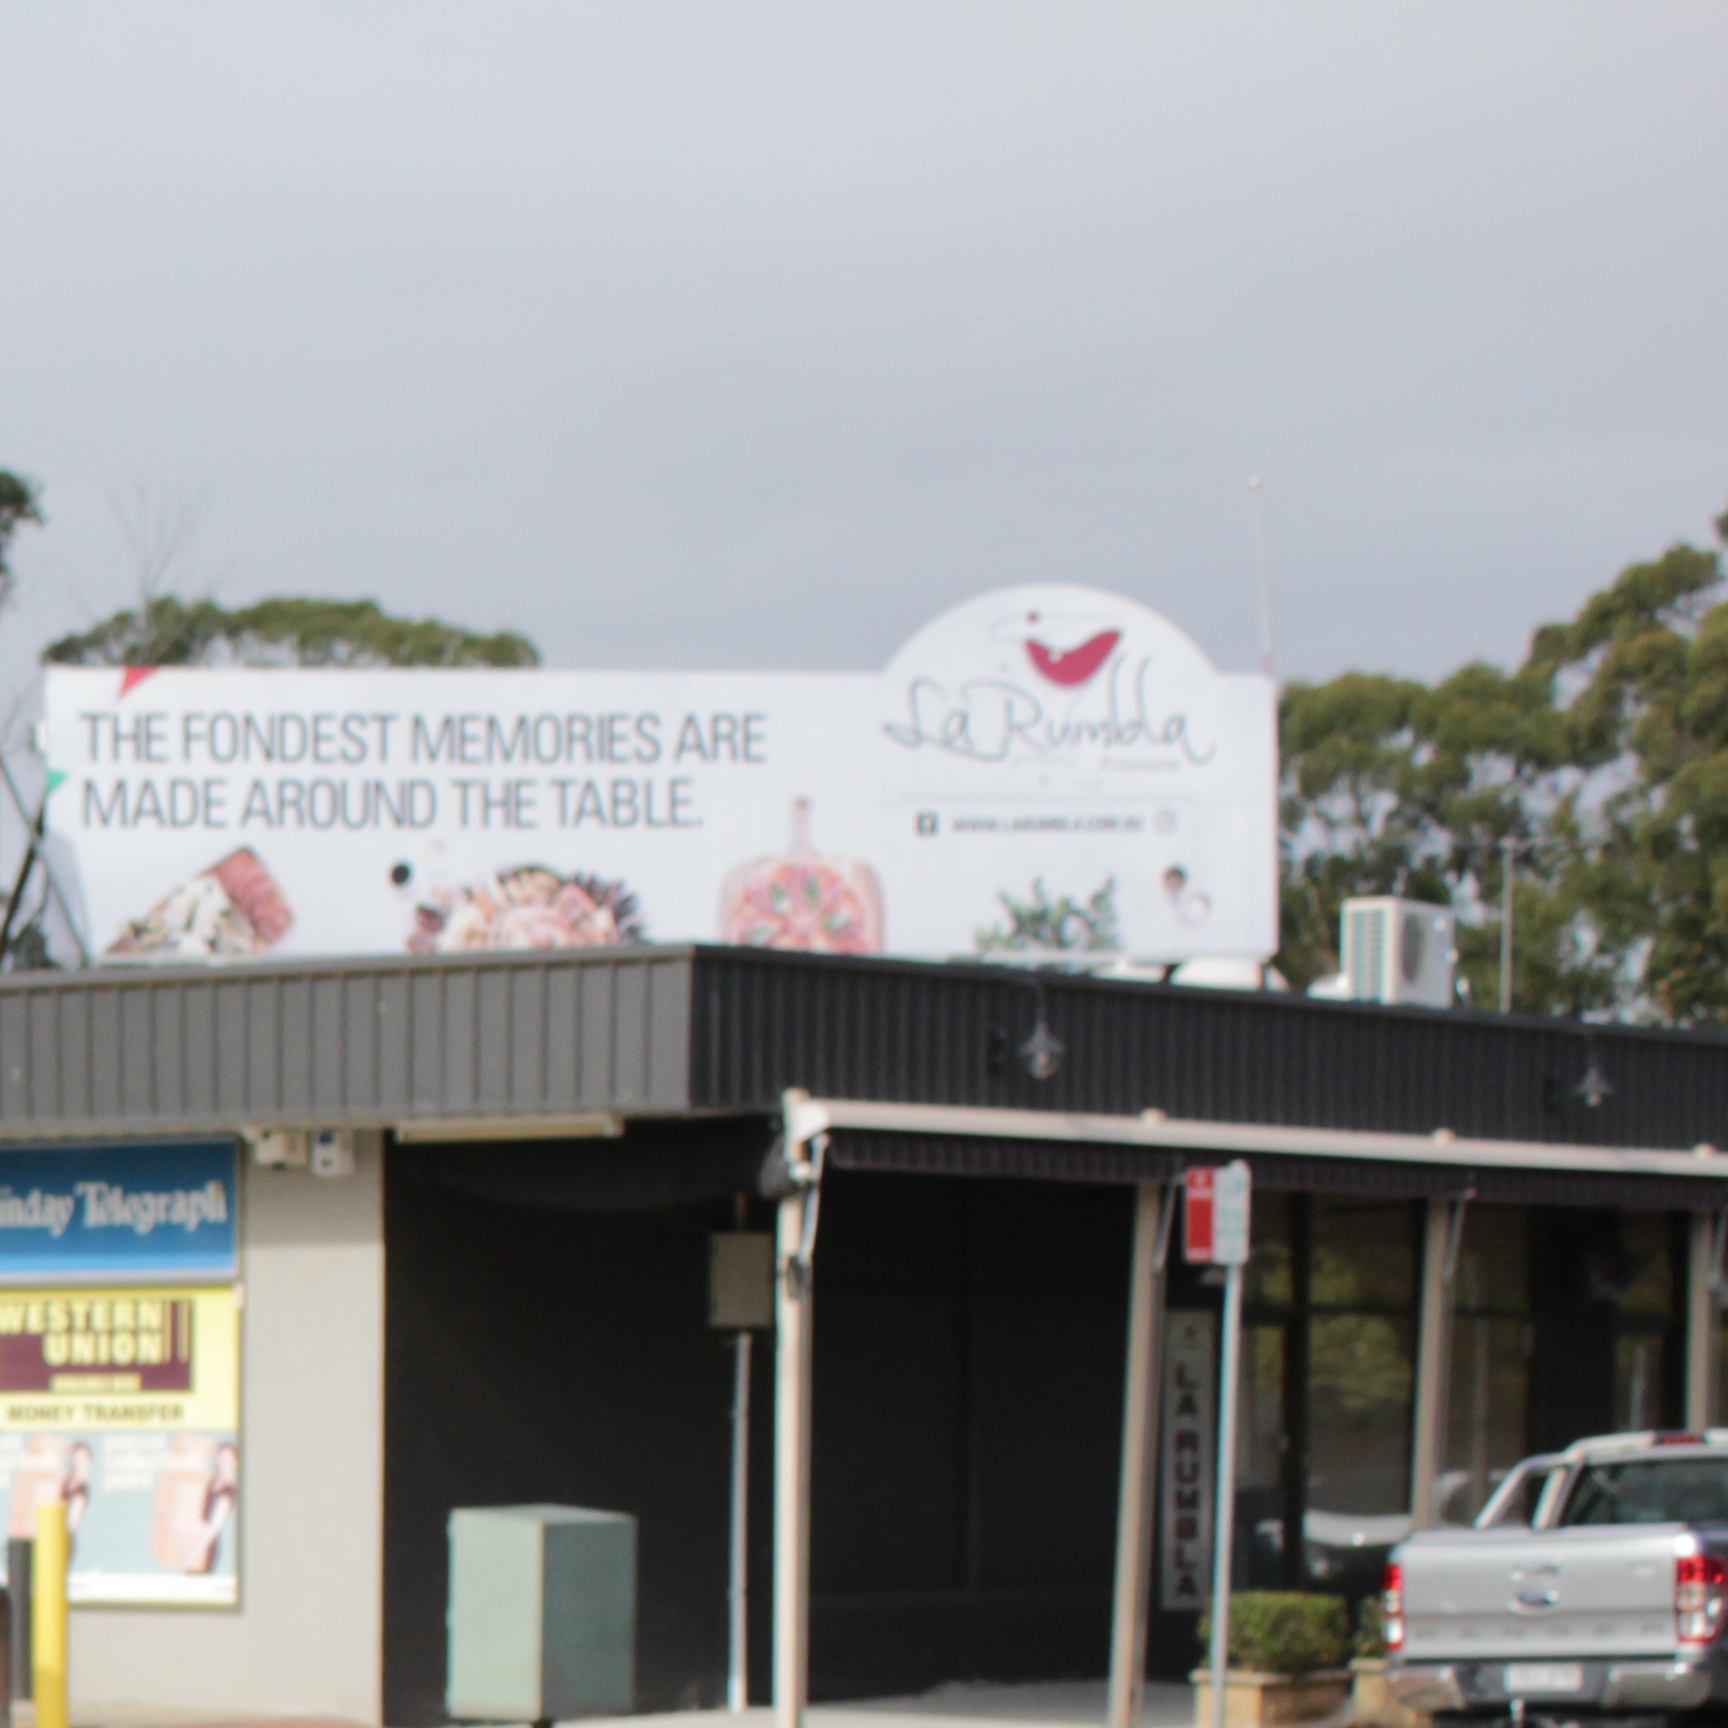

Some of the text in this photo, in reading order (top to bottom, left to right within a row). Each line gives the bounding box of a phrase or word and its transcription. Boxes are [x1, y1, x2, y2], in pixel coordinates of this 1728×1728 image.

[81, 711, 768, 764] THE FONDEST MEMORIES ARE
[84, 777, 704, 829] MADE AROUND THE TABLE.
[75, 1178, 228, 1234] Telegraph
[44, 1332, 165, 1367] UNION
[8, 1402, 185, 1423] MONEY TRANSFER
